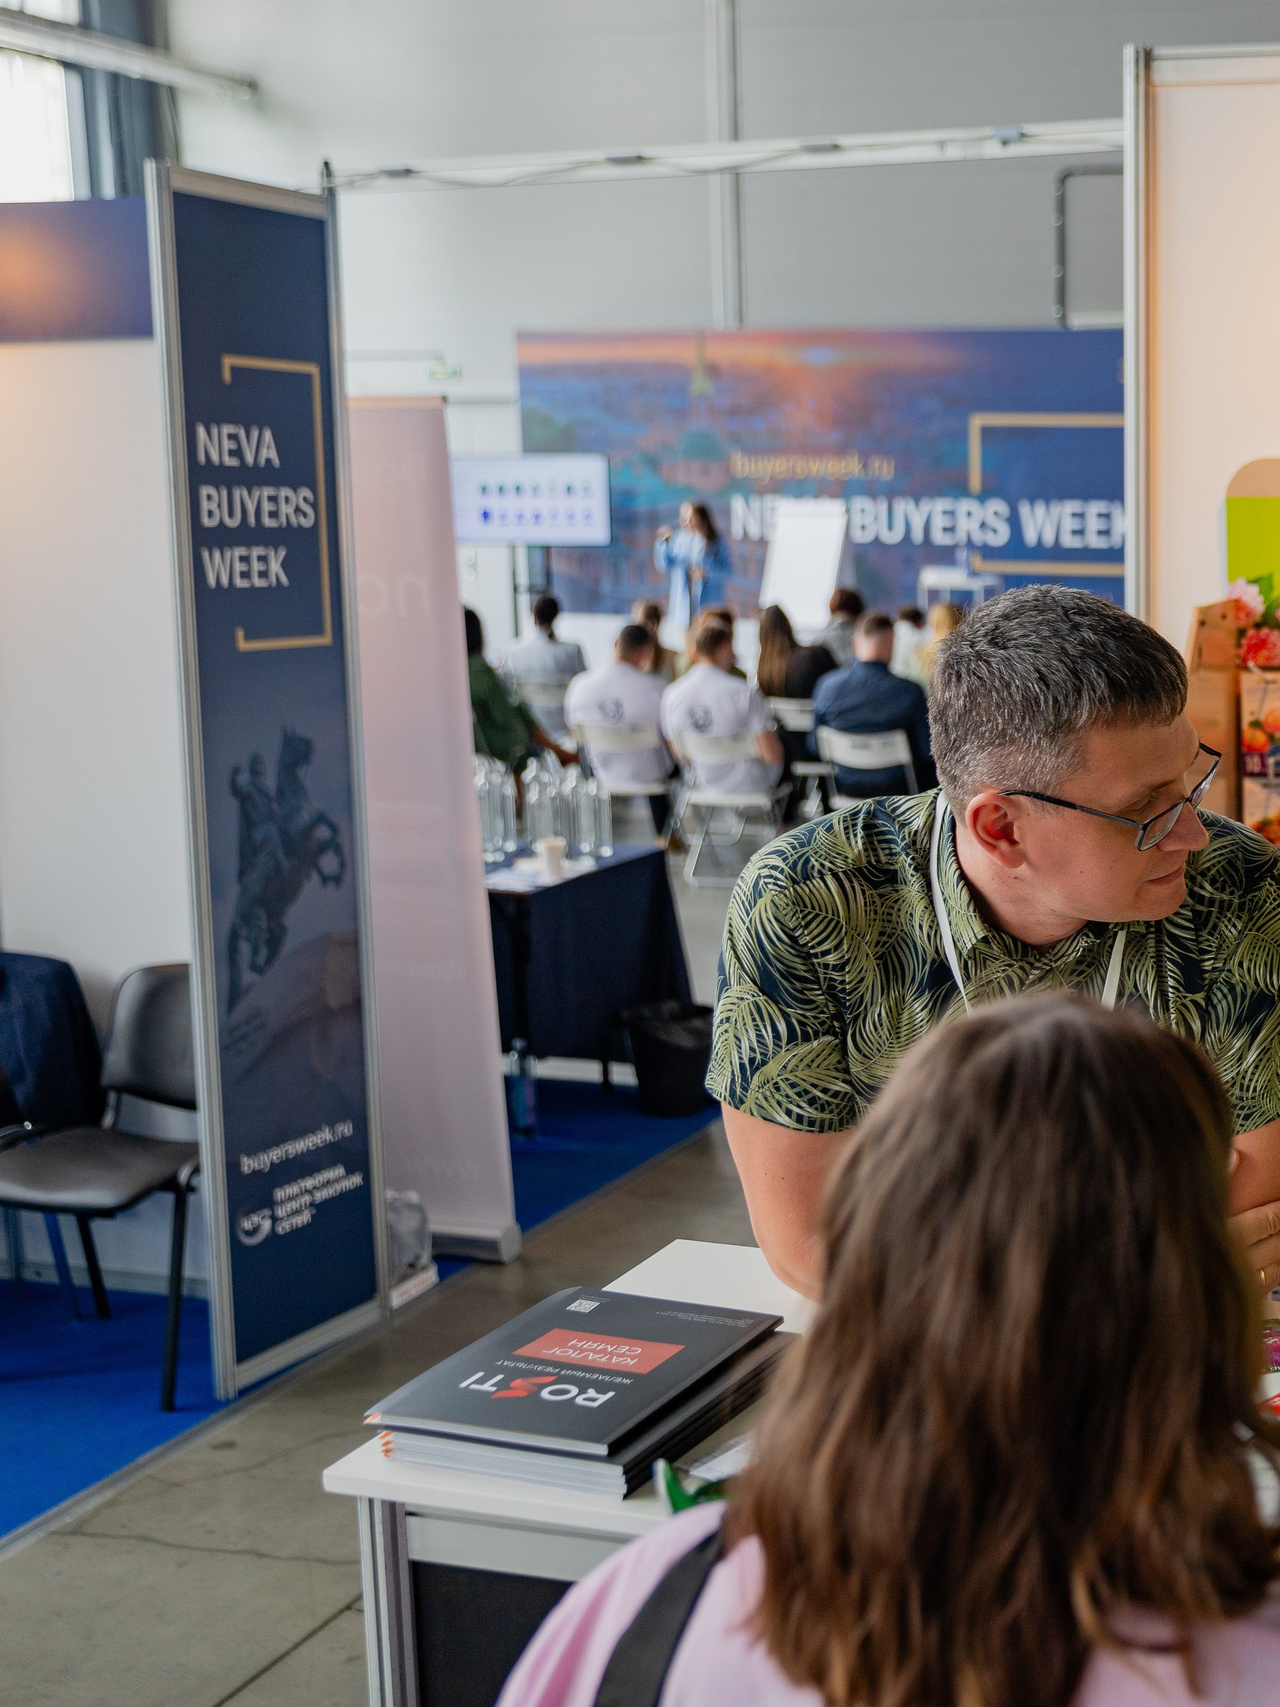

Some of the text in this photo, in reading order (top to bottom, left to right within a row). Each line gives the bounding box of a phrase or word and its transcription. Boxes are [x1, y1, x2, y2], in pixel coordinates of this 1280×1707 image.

[195, 421, 280, 469] NEVA
[199, 484, 316, 529] BUYERS
[848, 495, 1011, 549] BUYERS
[201, 545, 290, 589] WEEK
[239, 1119, 354, 1175] buyersweek.ru
[543, 1346, 639, 1367] КАТАЛОГ
[568, 1338, 642, 1355] СЕМЯН
[458, 1370, 616, 1408] ROSTI
[495, 1359, 634, 1385] ЖЕЛАЕМЫЙ РЕЗУЛЬТАТ
